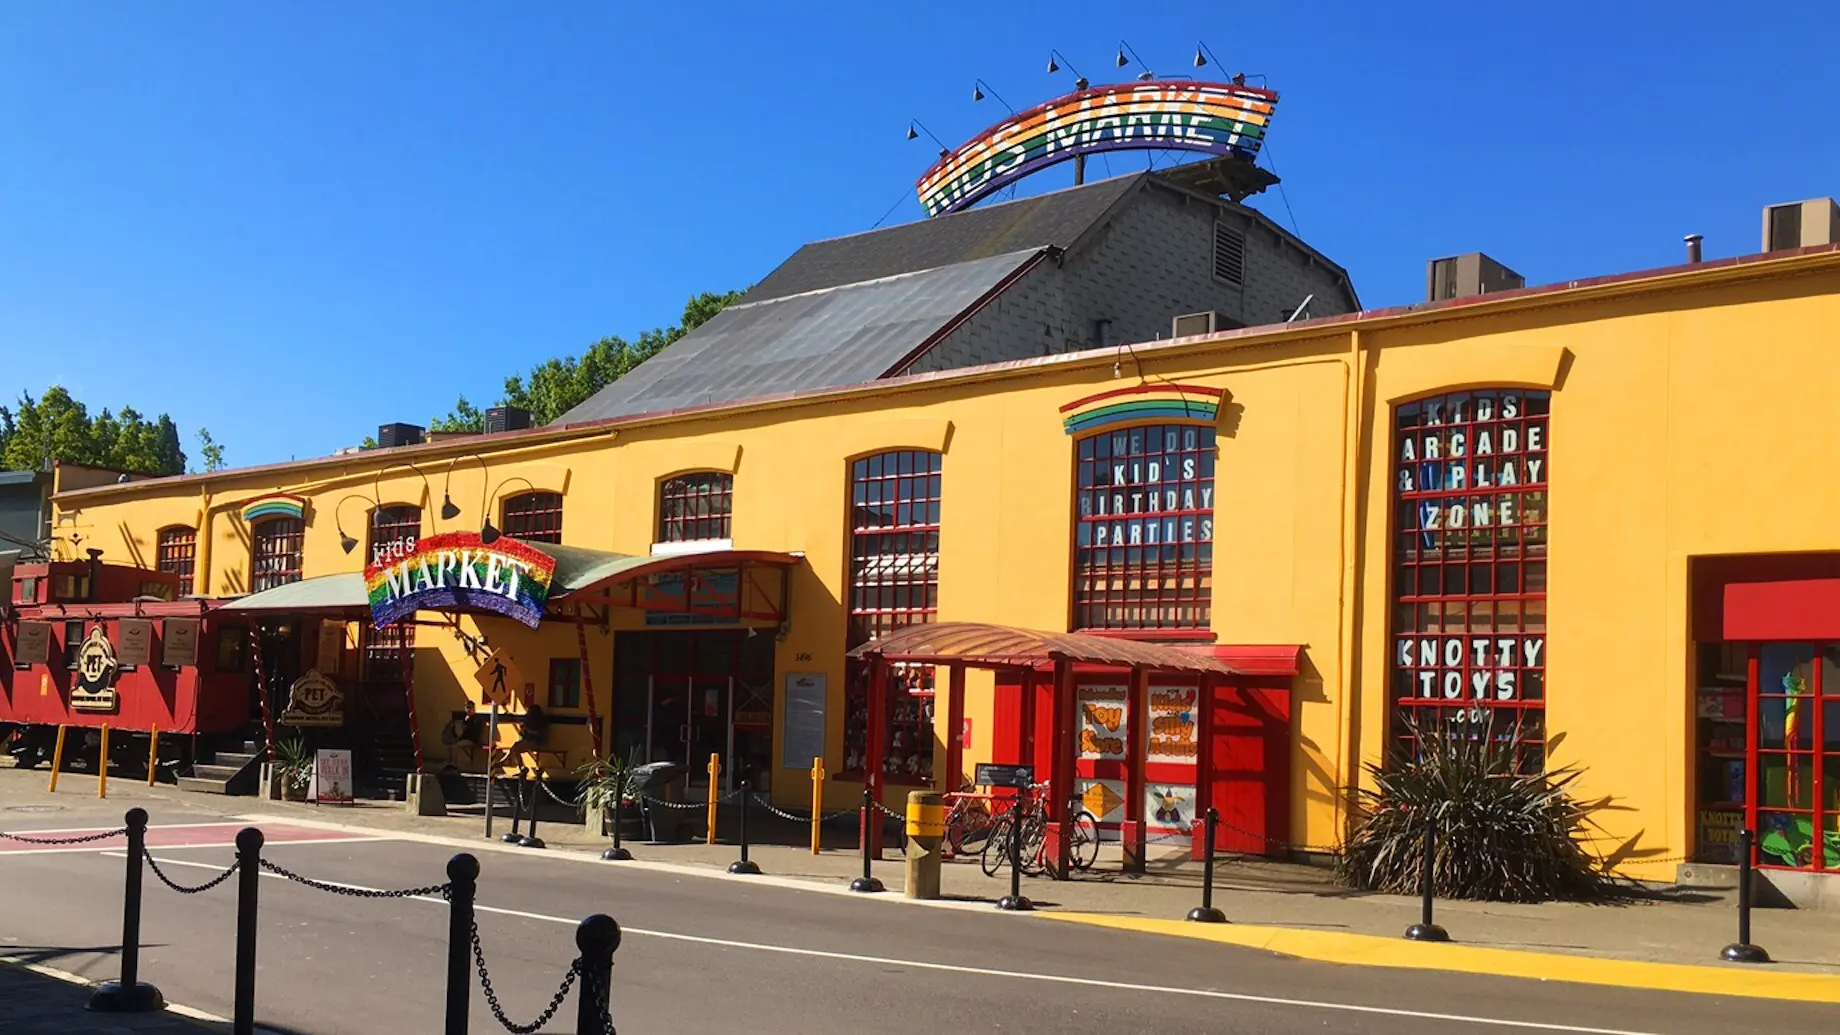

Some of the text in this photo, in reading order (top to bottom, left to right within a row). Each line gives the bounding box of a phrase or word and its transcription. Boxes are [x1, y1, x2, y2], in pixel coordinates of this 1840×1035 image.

[920, 85, 1267, 217] KIDS MARKET
[1427, 396, 1517, 426] KIDS
[1113, 430, 1196, 456] WE DO
[1402, 427, 1541, 460] ARCADE
[1399, 460, 1541, 491] & PLAY
[1080, 487, 1212, 515] BIRTHDAY
[1426, 501, 1513, 529] ZONE
[1097, 520, 1212, 546] PARTIES
[373, 536, 415, 567] kids
[384, 551, 529, 604] MARKET
[87, 655, 102, 672] PET
[1397, 639, 1543, 667] KNOTTY
[304, 688, 325, 700] PET
[1419, 671, 1515, 700] TOYS
[1083, 703, 1122, 732] Toy
